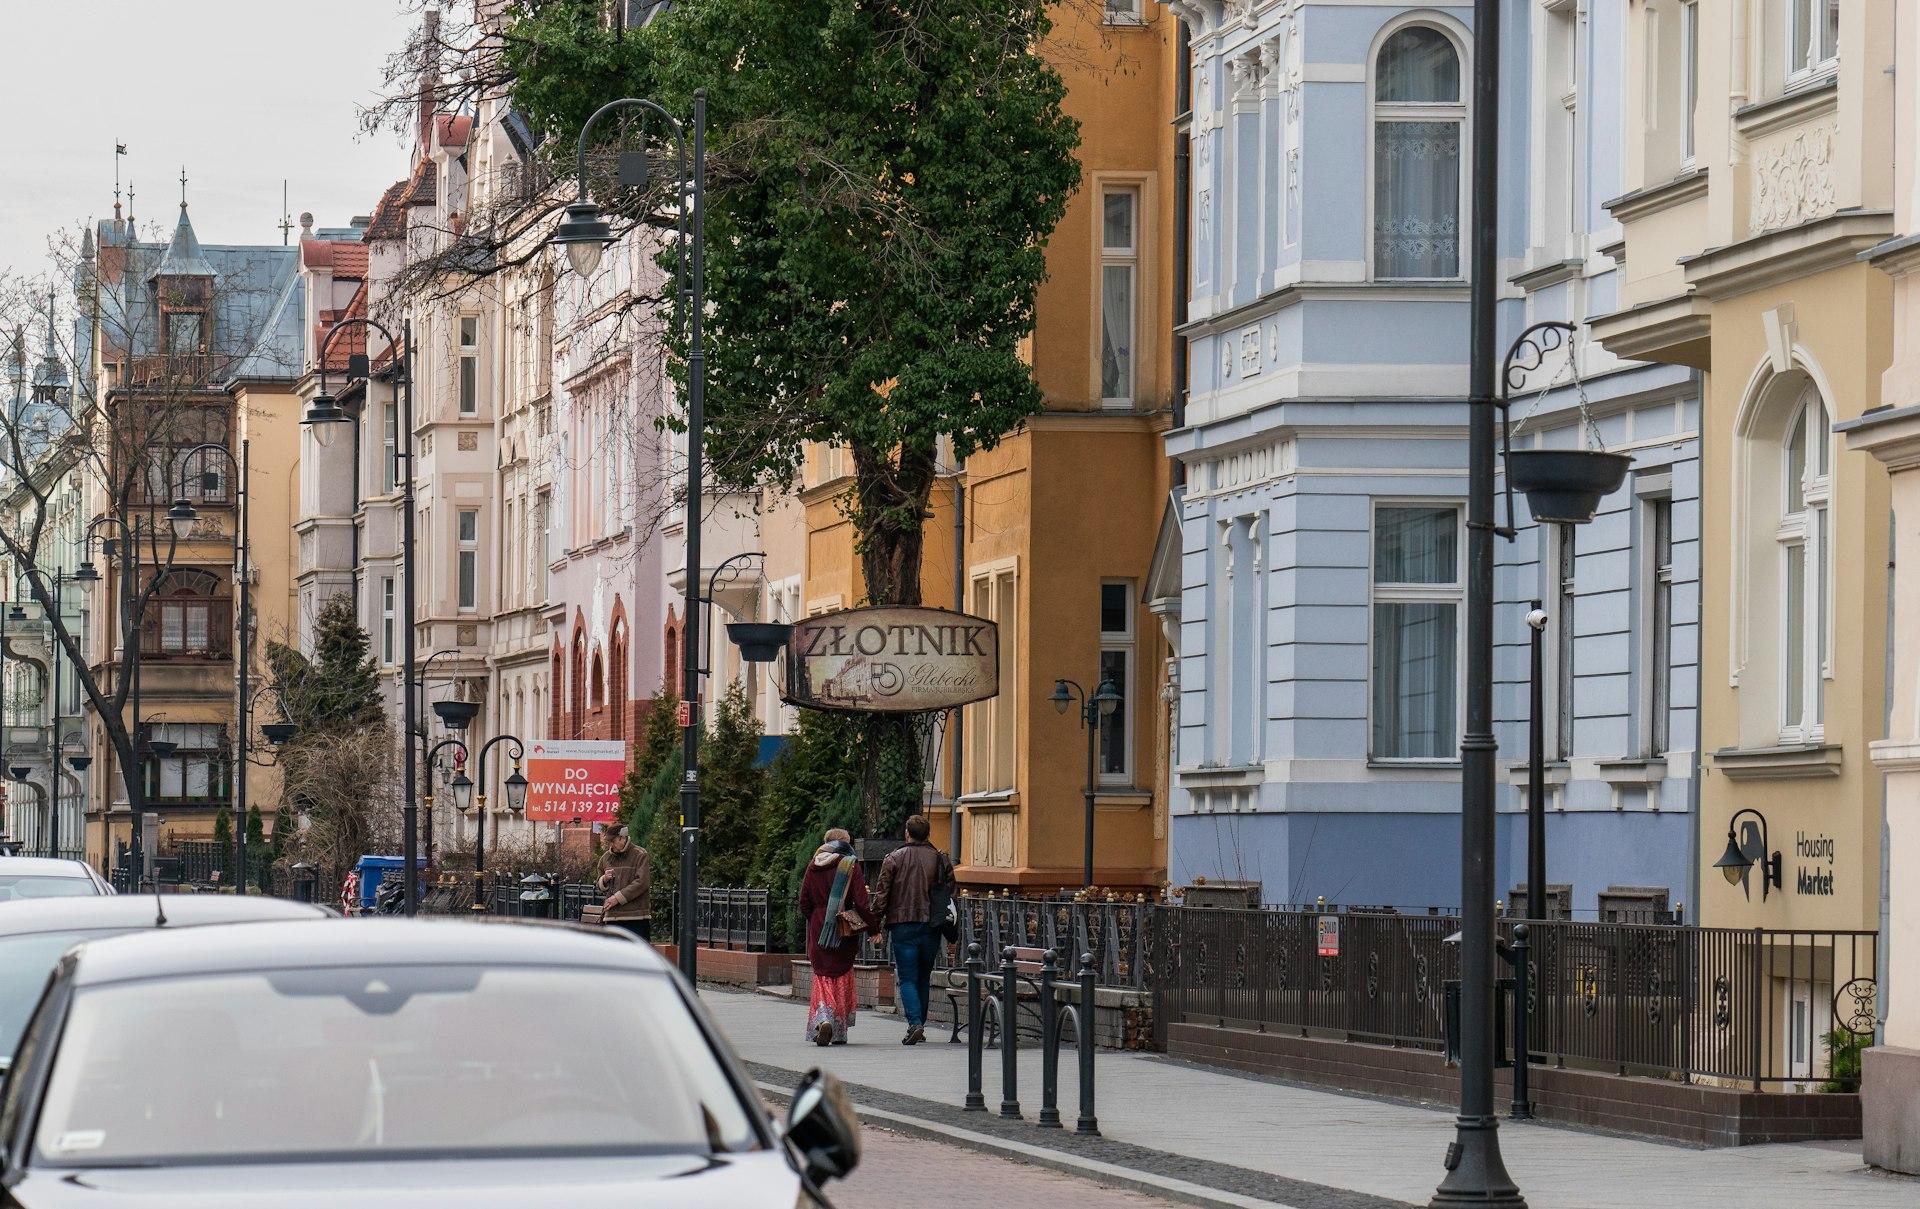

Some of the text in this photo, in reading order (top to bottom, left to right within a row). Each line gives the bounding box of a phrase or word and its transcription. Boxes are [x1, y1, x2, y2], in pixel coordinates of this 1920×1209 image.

[803, 624, 987, 657] ZŁOTNIK
[565, 768, 588, 780] DO
[531, 782, 620, 797] WYNAJĘCIA
[532, 800, 619, 813] tel. 514 139 218
[1796, 830, 1834, 865] Housing
[1797, 866, 1834, 895] Market
